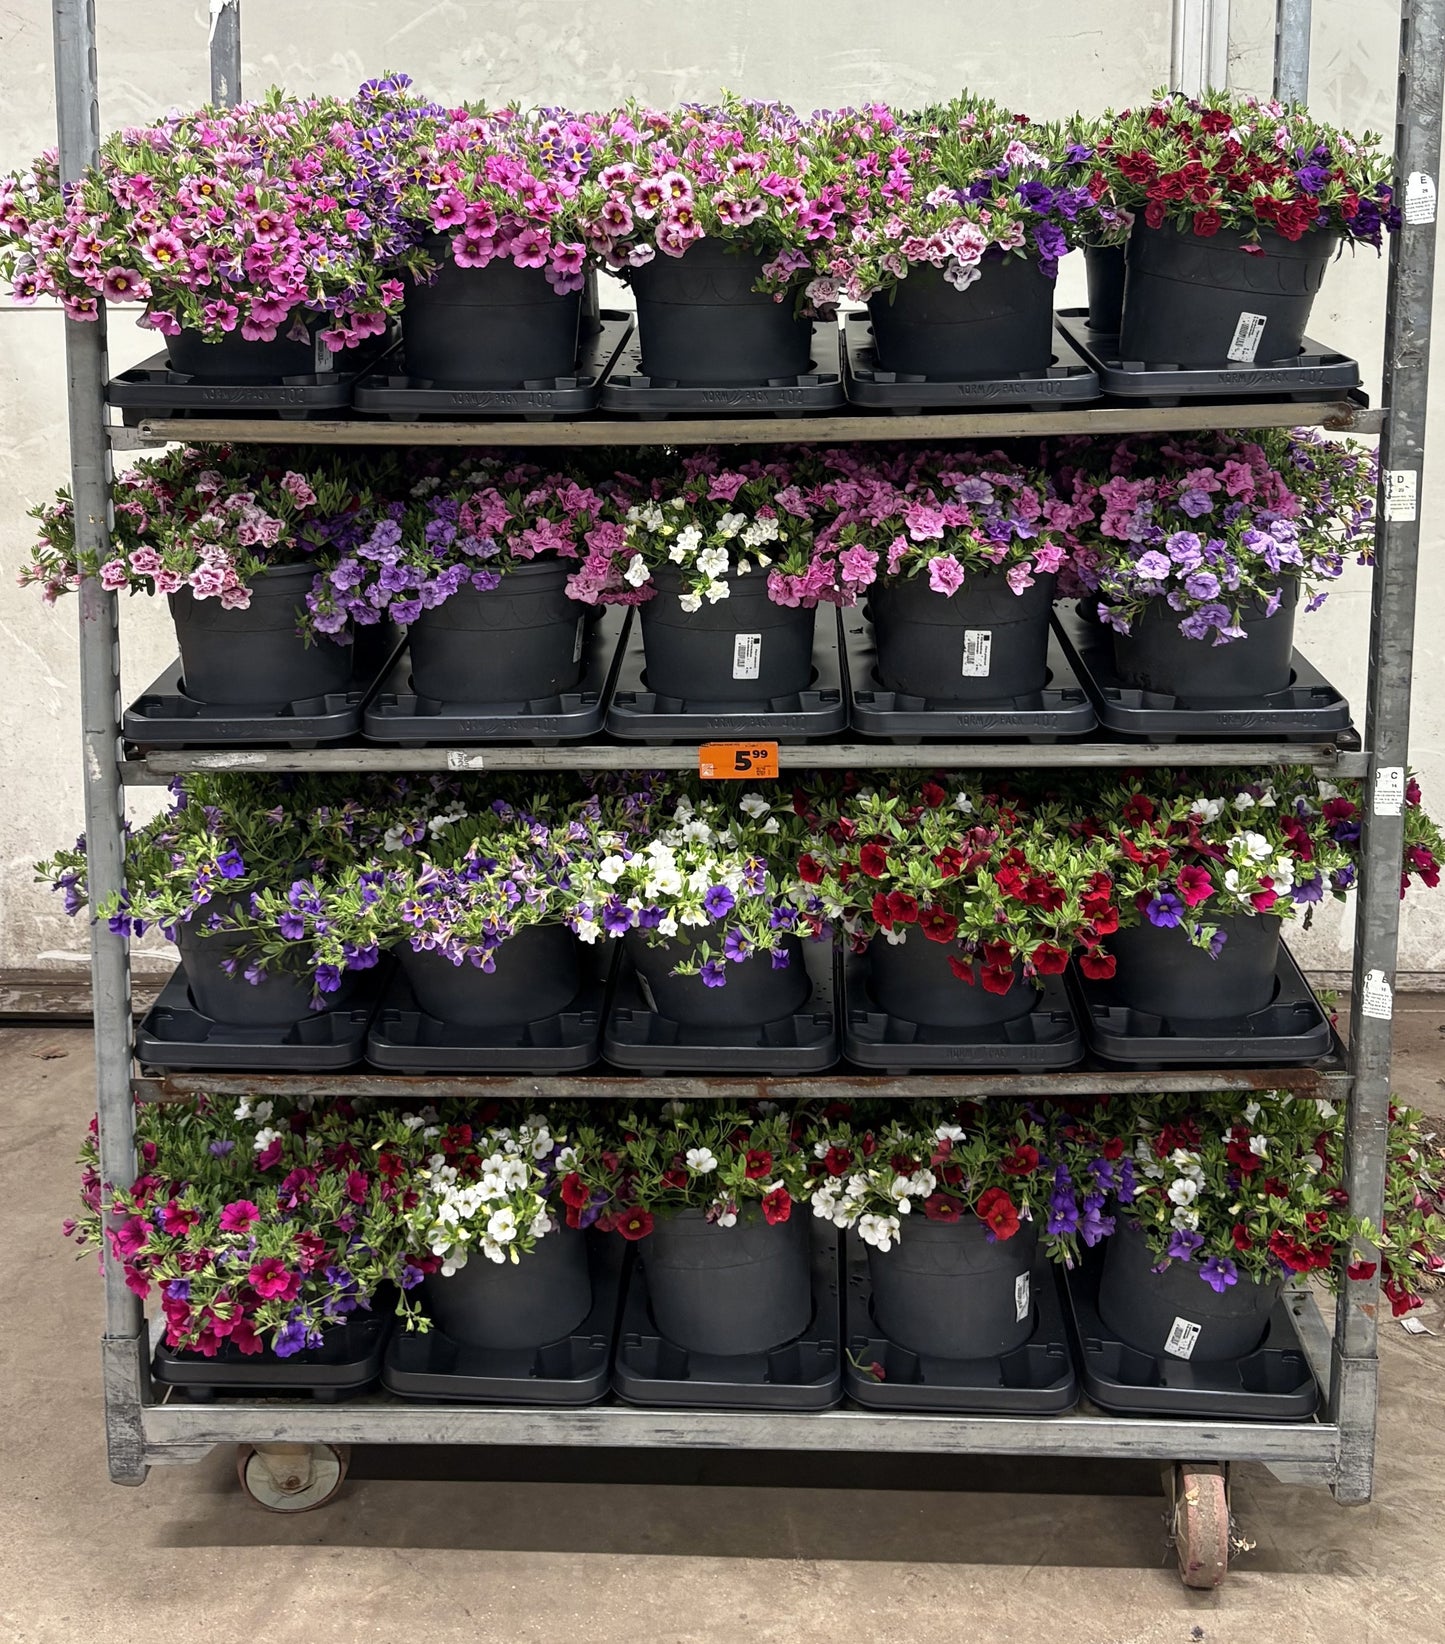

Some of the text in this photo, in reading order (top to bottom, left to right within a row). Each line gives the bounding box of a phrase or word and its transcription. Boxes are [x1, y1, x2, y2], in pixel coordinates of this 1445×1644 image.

[1218, 369, 1324, 385] NORM PACK 402
[702, 389, 803, 404] NORM PACK 402
[958, 381, 1062, 397] NORM PACK 402
[527, 391, 552, 407] 402
[1397, 475, 1404, 483] D
[707, 717, 735, 728] NORM
[957, 714, 1057, 729] NORM PACK 402
[1391, 771, 1398, 779] C
